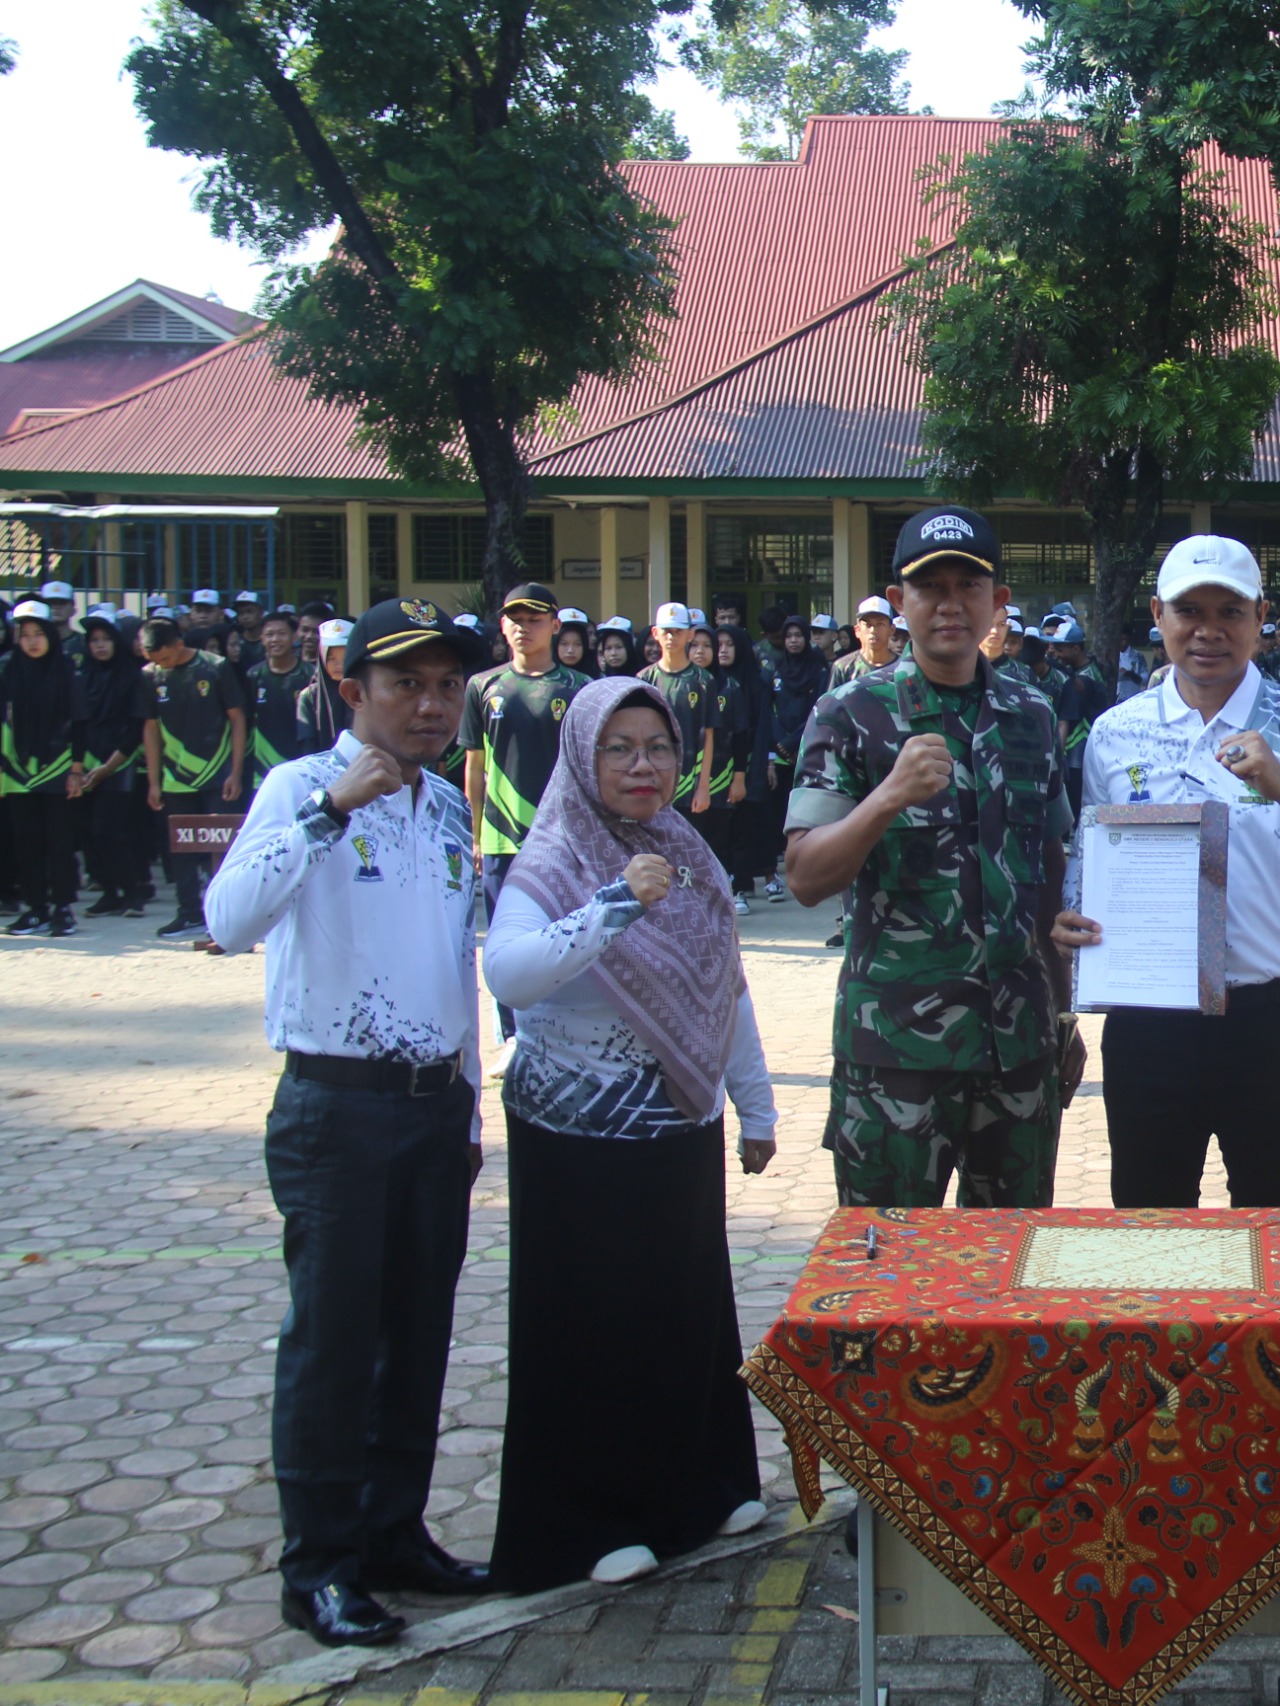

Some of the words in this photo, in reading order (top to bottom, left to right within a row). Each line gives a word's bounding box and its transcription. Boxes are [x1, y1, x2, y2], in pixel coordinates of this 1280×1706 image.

[925, 517, 969, 533] KODIM
[933, 530, 962, 540] 0423
[176, 827, 194, 843] XI
[197, 827, 233, 843] DKV
